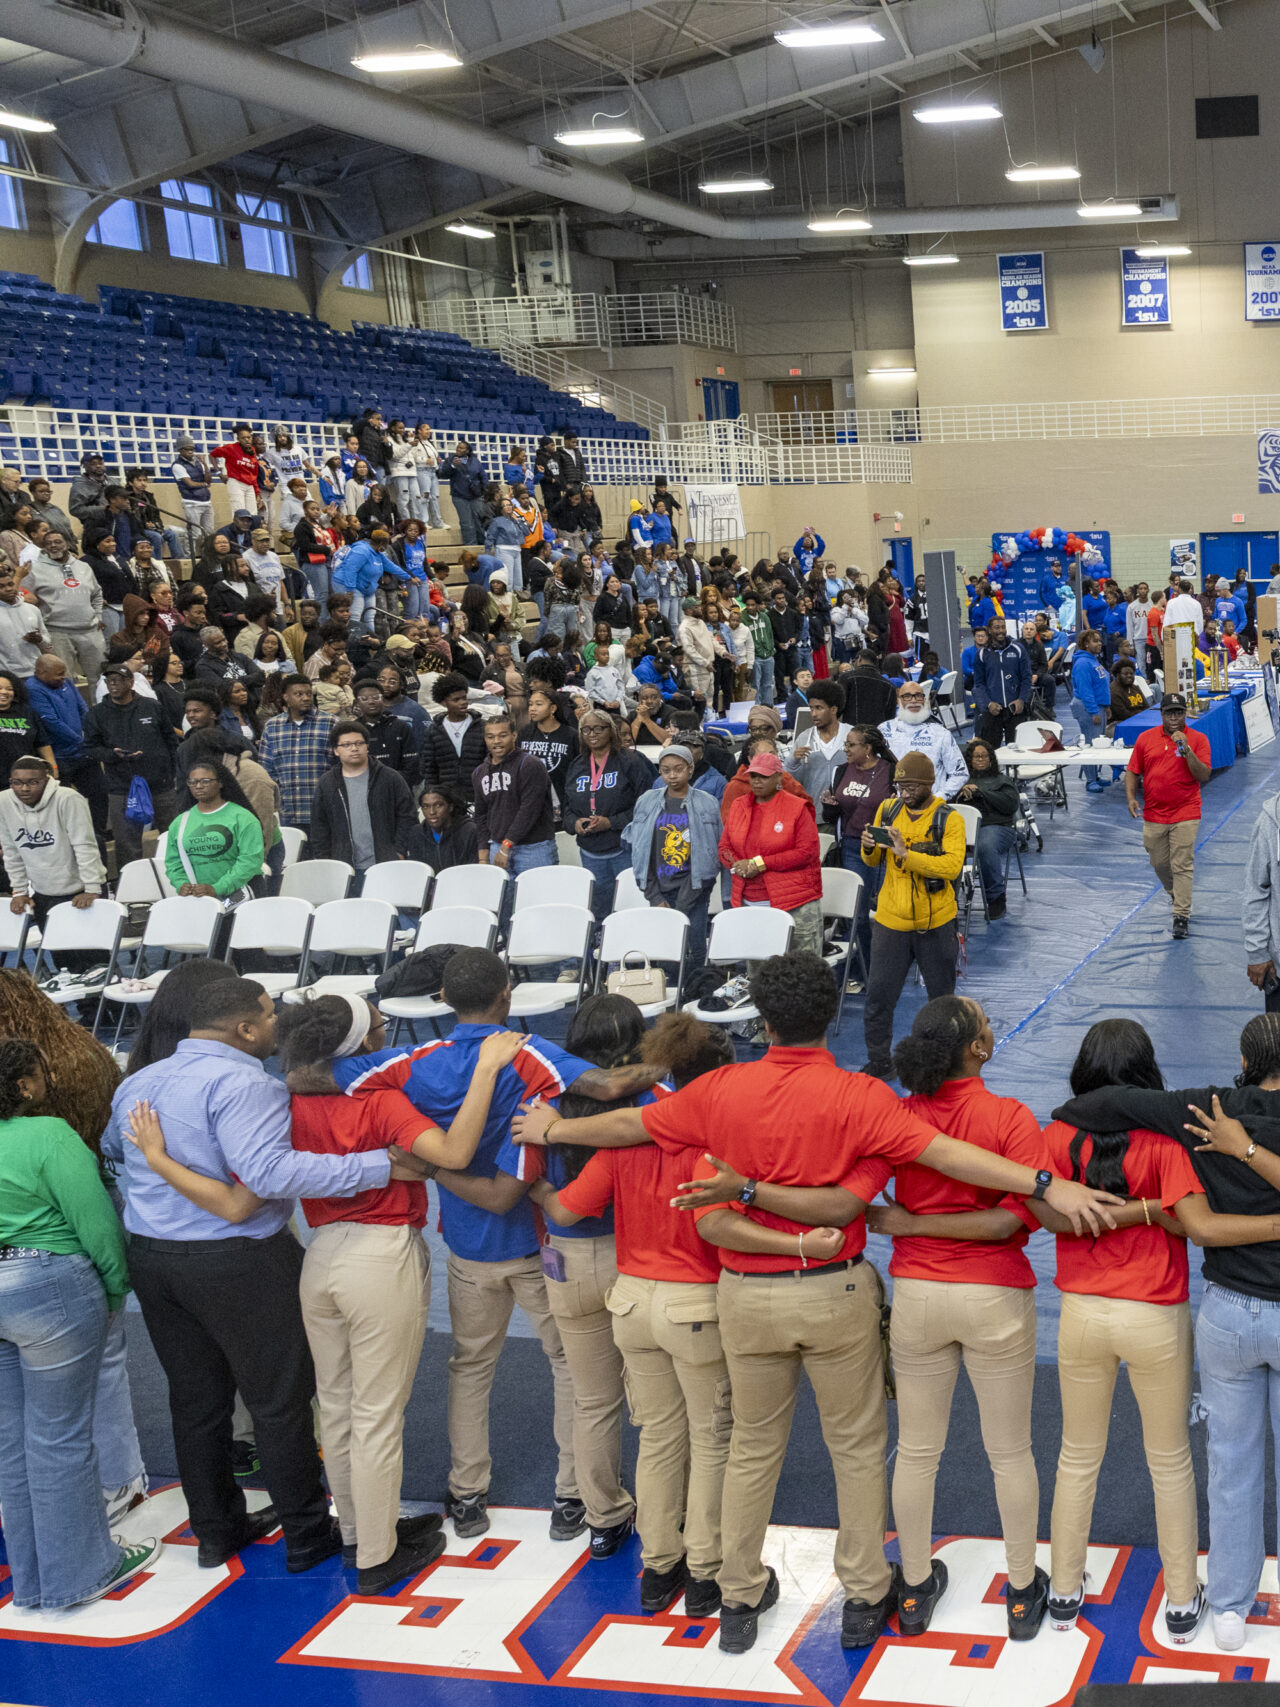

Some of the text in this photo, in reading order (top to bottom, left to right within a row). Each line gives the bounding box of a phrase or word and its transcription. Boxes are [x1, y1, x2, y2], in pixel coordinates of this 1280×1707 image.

[1001, 279, 1042, 287] CHAMPIONS
[1124, 273, 1166, 281] CHAMPIONS
[1005, 299, 1041, 314] 2005
[1127, 293, 1164, 308] 2007
[551, 743, 568, 755] STATE
[481, 772, 512, 796] GAP
[656, 812, 689, 830] HIRA
[189, 836, 219, 844] YOUNG
